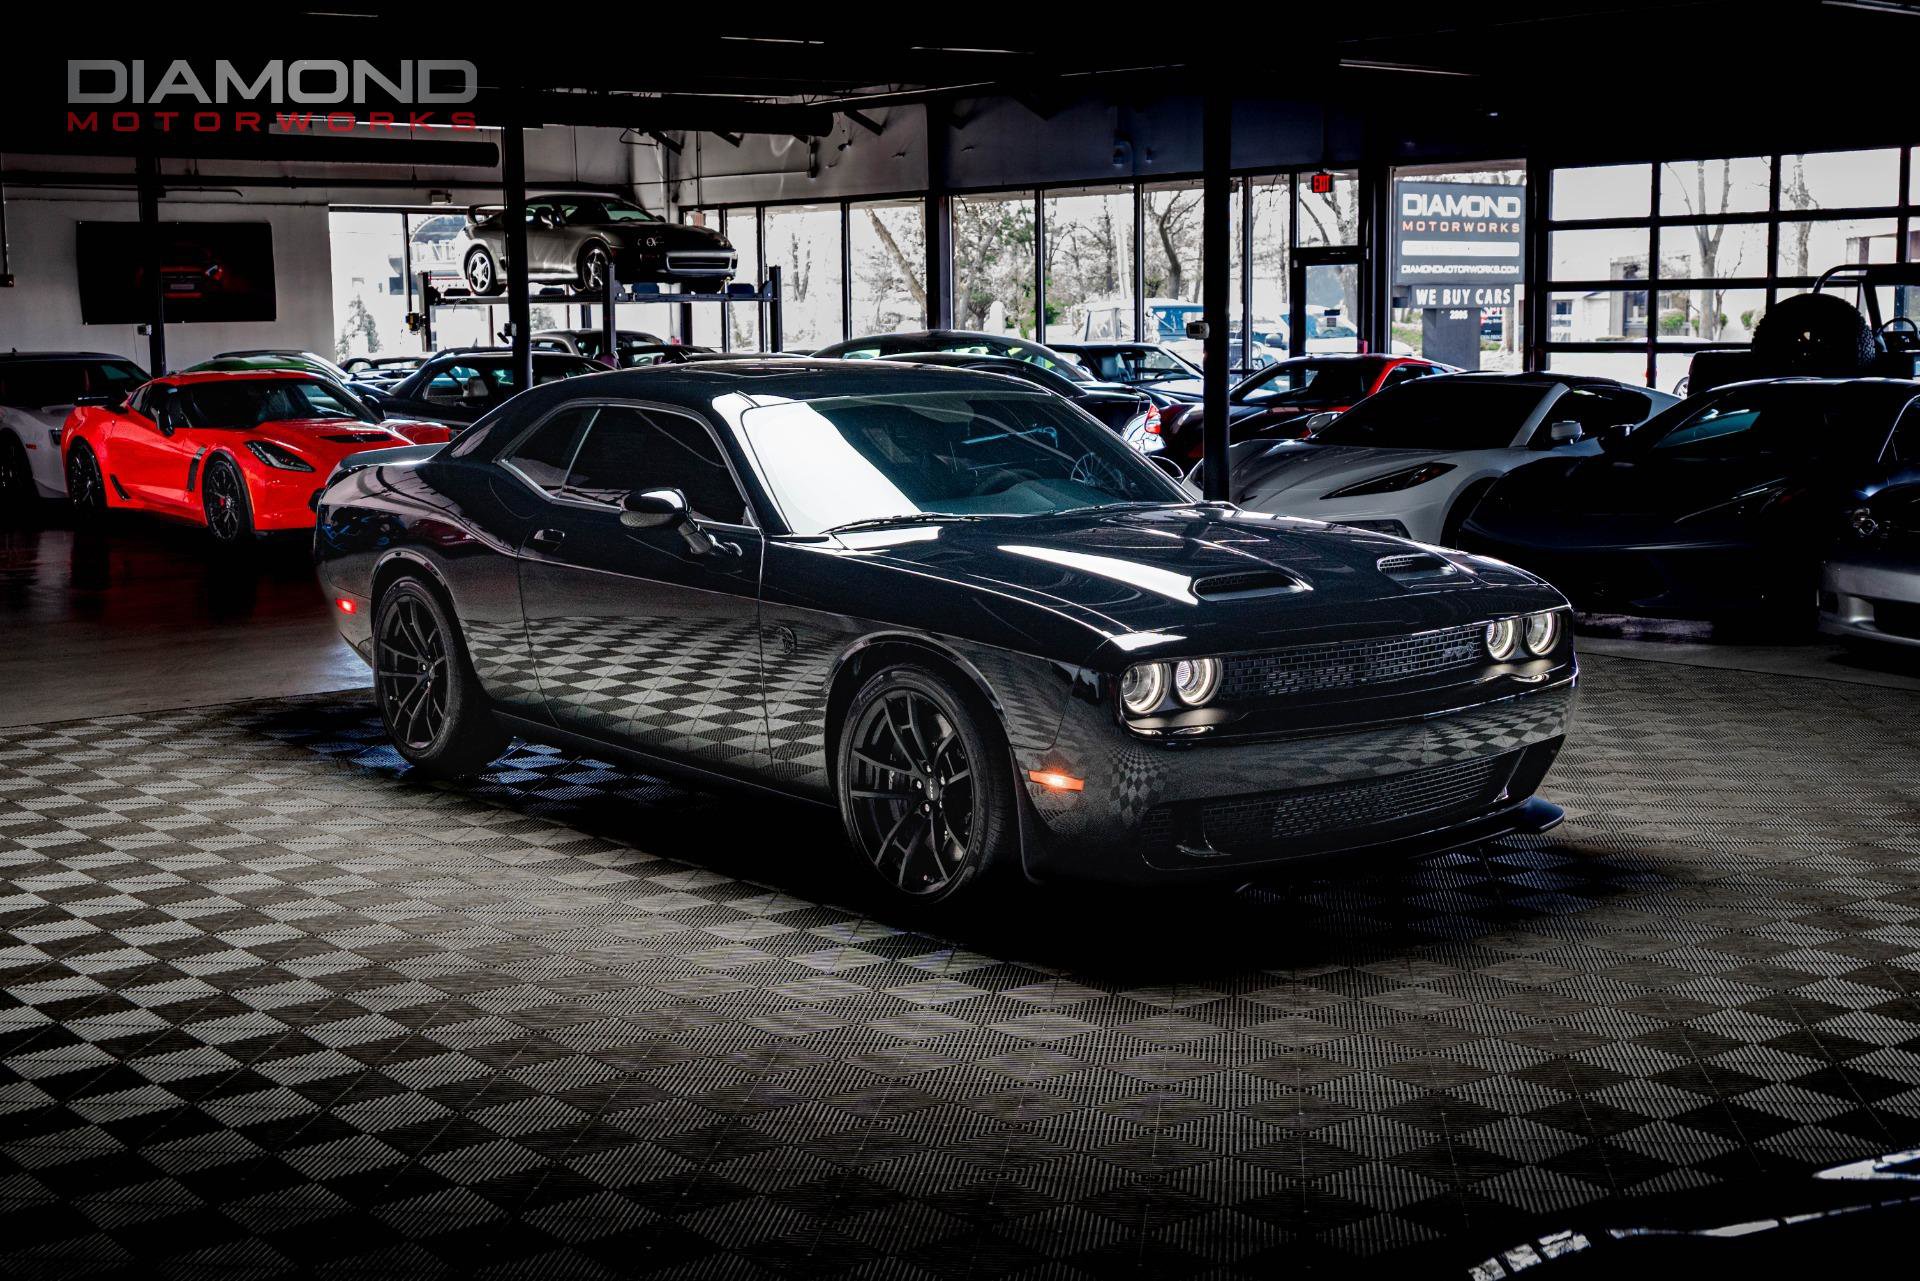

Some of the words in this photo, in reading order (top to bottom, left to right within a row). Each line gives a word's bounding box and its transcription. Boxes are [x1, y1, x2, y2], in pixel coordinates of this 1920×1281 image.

[1402, 193, 1521, 219] DIAMOND
[1402, 221, 1520, 233] MOTORWORKS
[1416, 288, 1437, 305] WE
[1442, 288, 1471, 305] BUY
[1475, 288, 1511, 305] CARS
